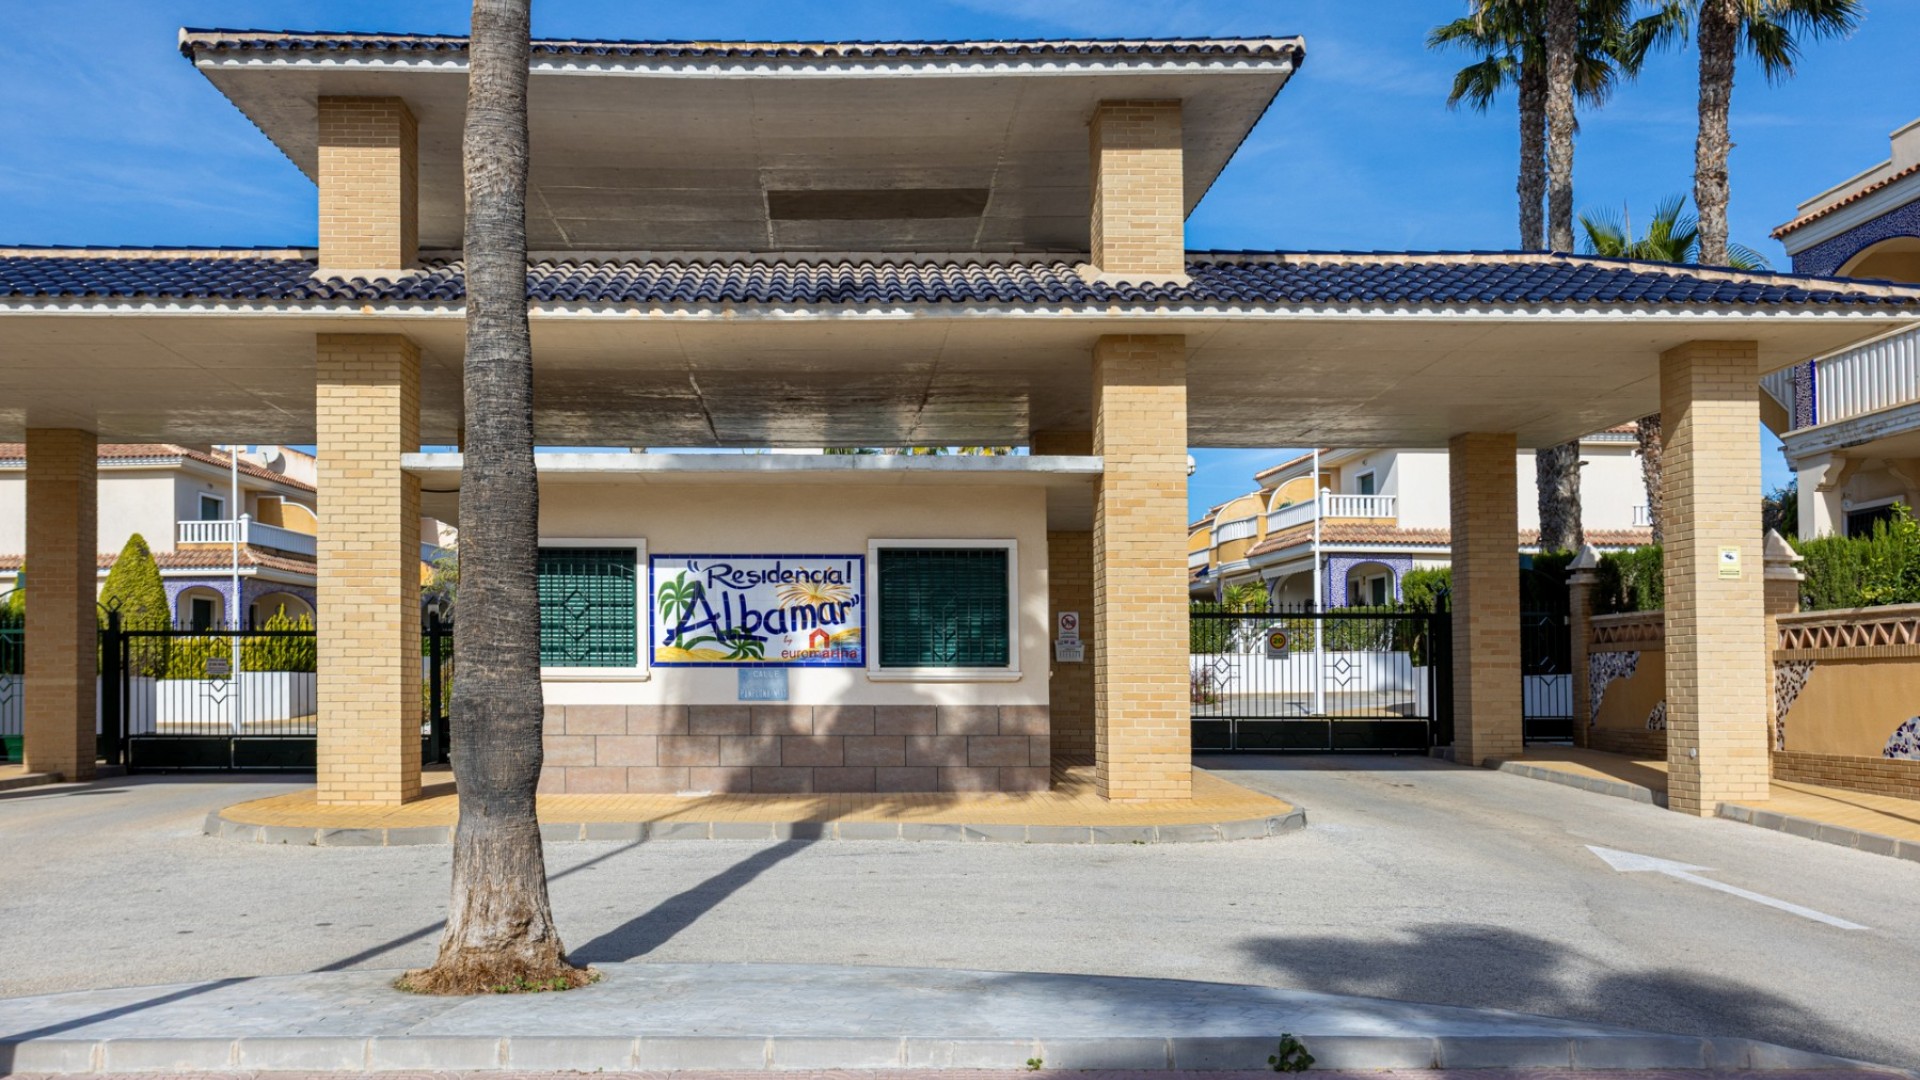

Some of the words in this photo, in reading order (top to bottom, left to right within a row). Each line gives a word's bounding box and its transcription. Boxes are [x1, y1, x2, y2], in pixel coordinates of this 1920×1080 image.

[783, 635, 793, 646] by
[781, 649, 858, 659] euromarina
[752, 670, 780, 678] CALLE
